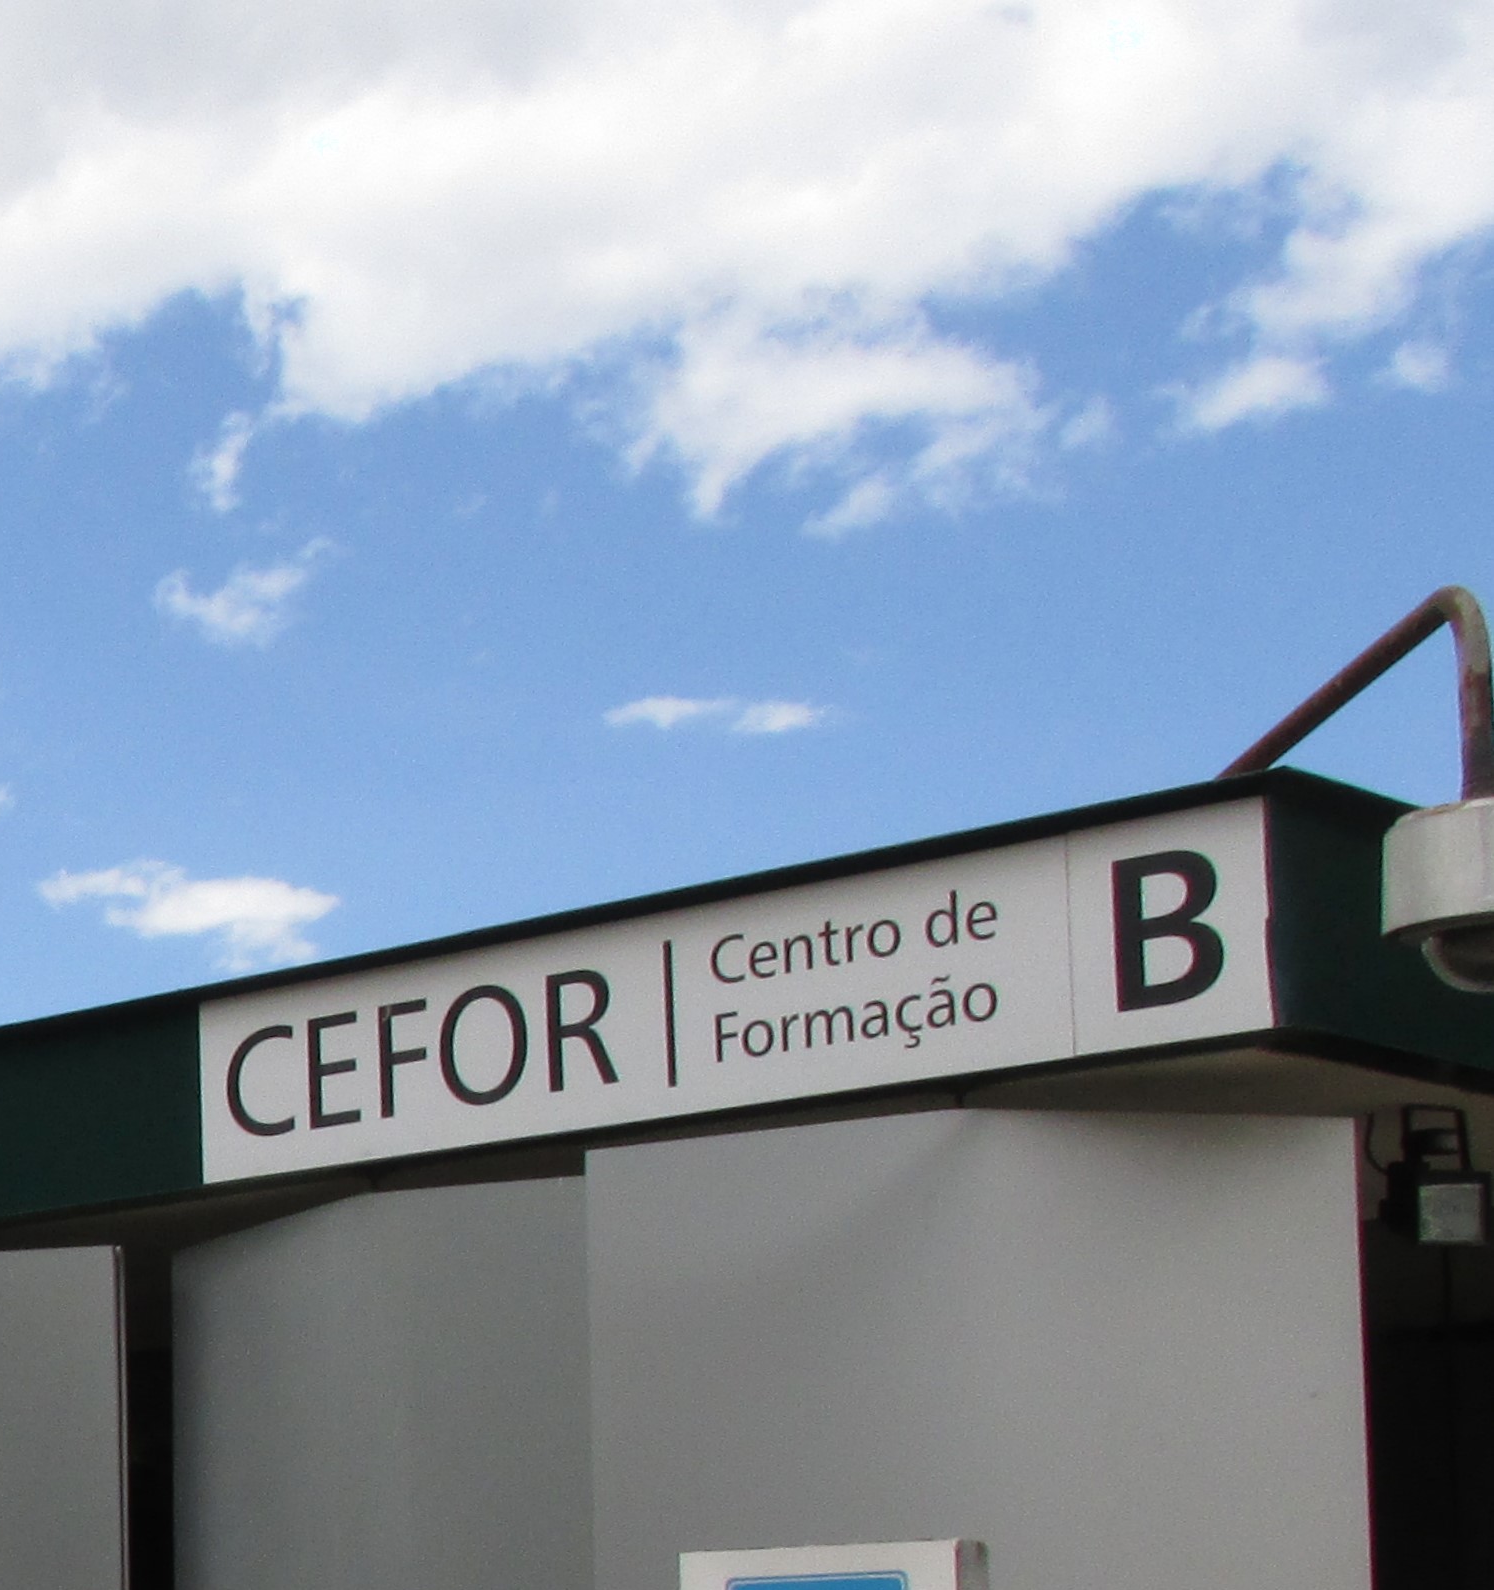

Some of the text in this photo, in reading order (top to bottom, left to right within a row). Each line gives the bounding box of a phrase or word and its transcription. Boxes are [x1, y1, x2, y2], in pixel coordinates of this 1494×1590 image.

[709, 889, 999, 984] Centro de
[1111, 849, 1225, 1013] B
[225, 968, 620, 1138] CEFOR
[714, 976, 999, 1063] Formação
